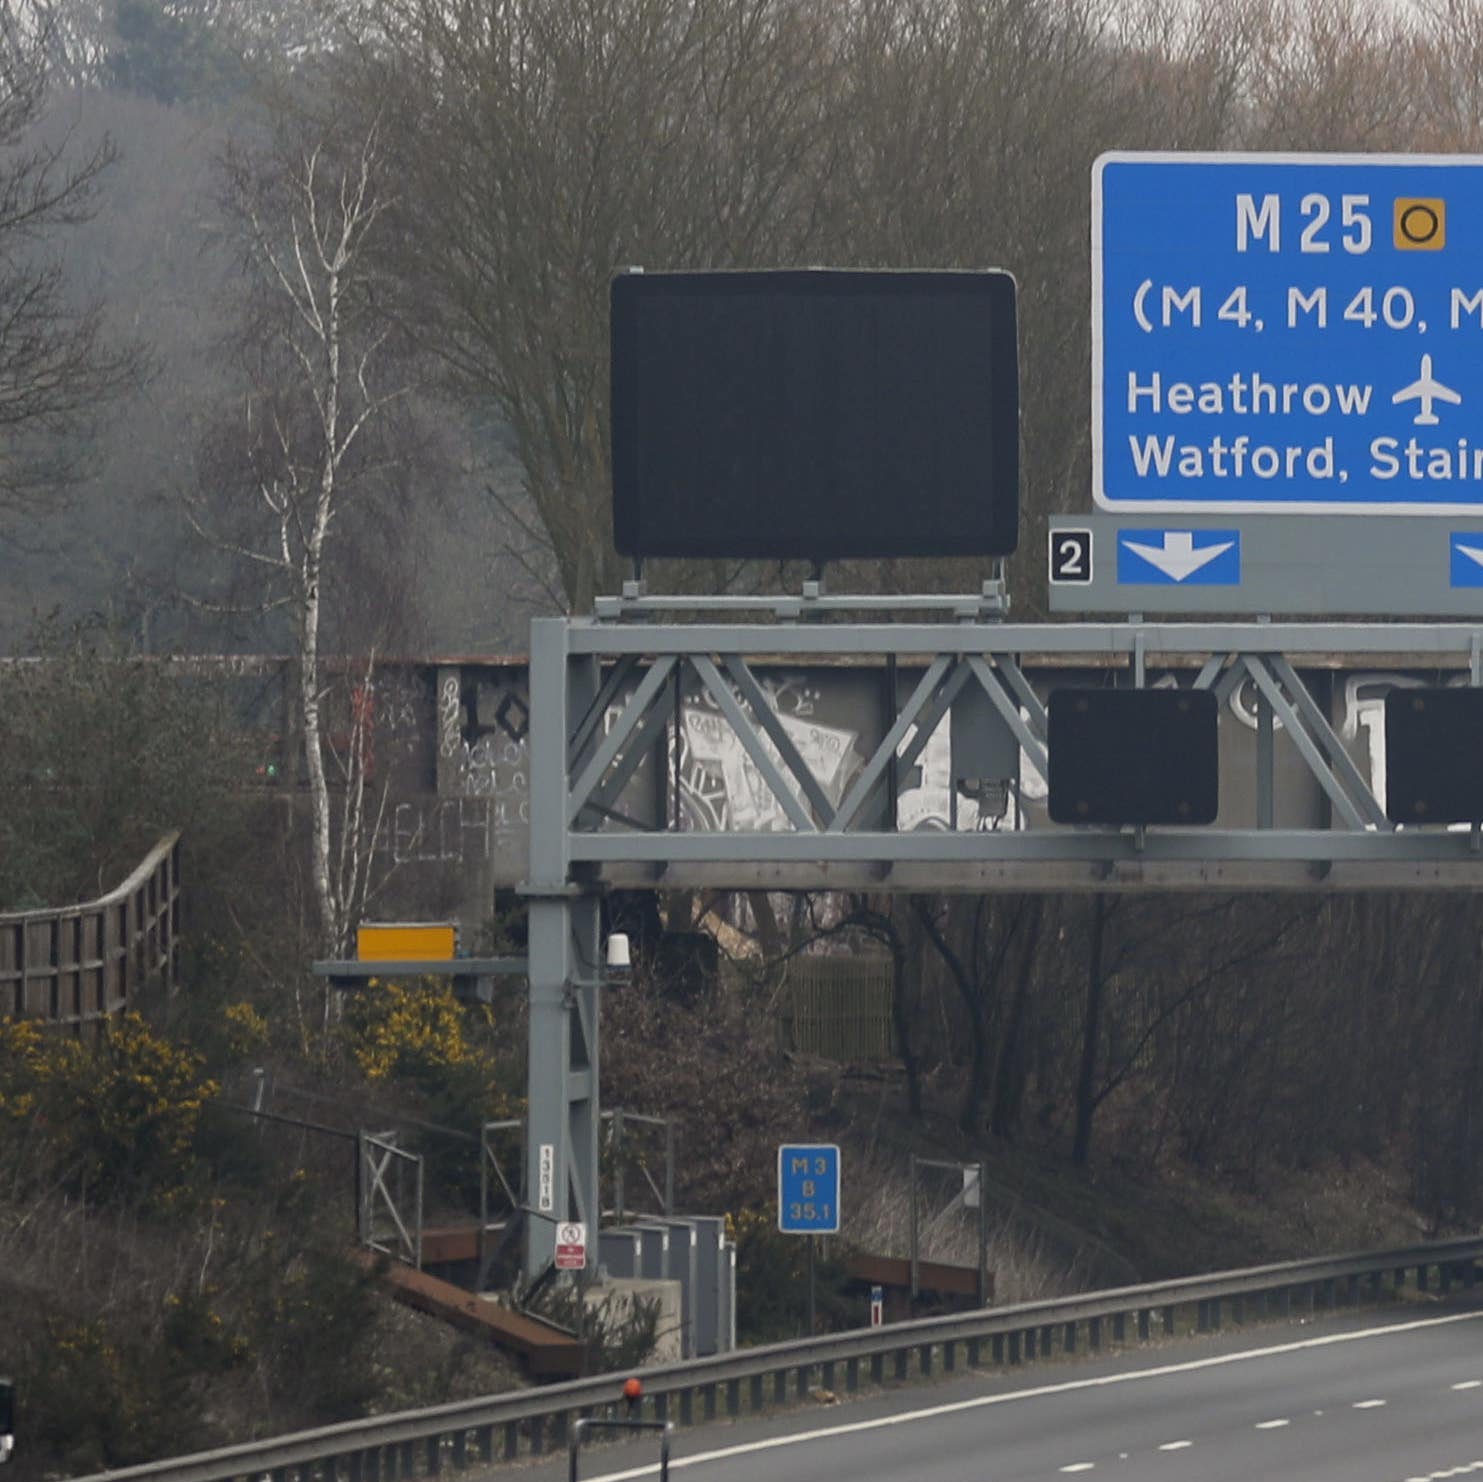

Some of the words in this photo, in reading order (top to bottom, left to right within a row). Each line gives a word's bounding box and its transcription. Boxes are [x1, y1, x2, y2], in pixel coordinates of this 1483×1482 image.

[1127, 372, 1373, 415] Heathrow
[1129, 436, 1348, 483] Watford,
[1059, 541, 1083, 574] 2
[790, 1203, 830, 1221] 35.1
